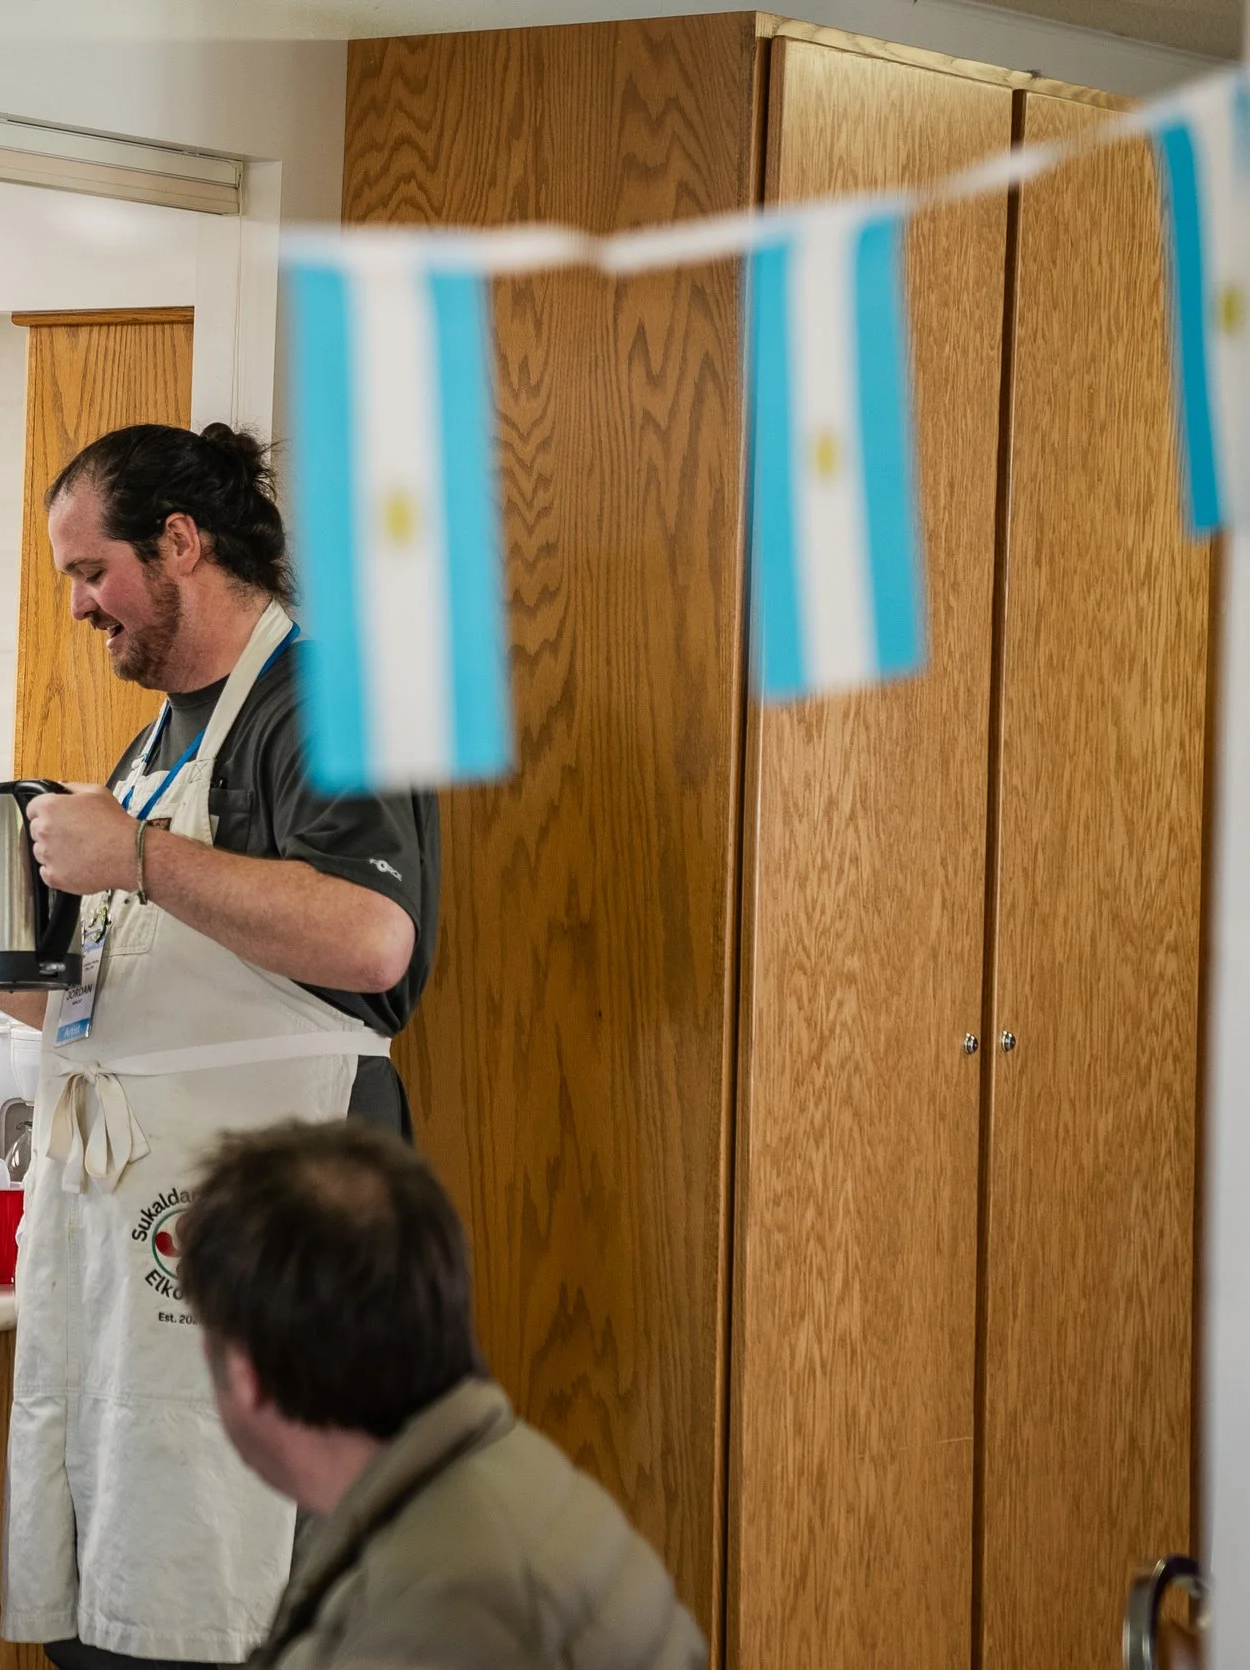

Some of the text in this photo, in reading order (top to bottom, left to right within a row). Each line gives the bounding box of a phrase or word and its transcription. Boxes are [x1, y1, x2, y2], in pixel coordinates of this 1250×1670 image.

[66, 983, 93, 1001] JORDAN
[158, 1311, 196, 1325] Est. 20
